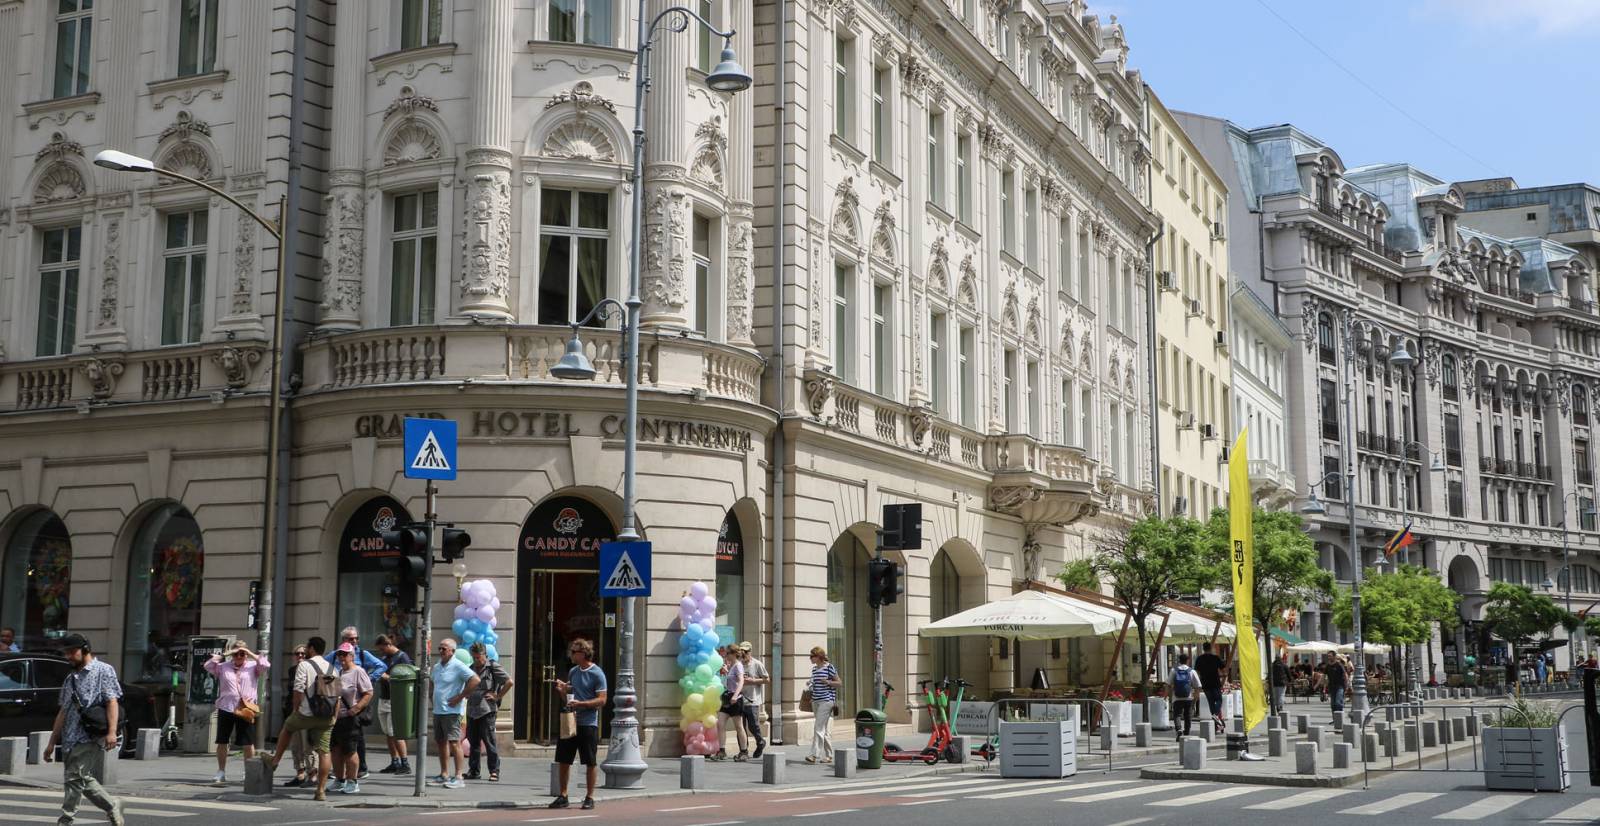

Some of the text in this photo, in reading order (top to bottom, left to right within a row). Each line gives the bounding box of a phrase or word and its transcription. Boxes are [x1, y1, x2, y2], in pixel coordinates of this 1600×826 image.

[354, 412, 447, 438] GRA
[472, 411, 580, 437] HOTEL
[350, 537, 390, 551] CAND
[524, 536, 611, 551] CANDY CA
[984, 623, 1024, 632] PURCARI
